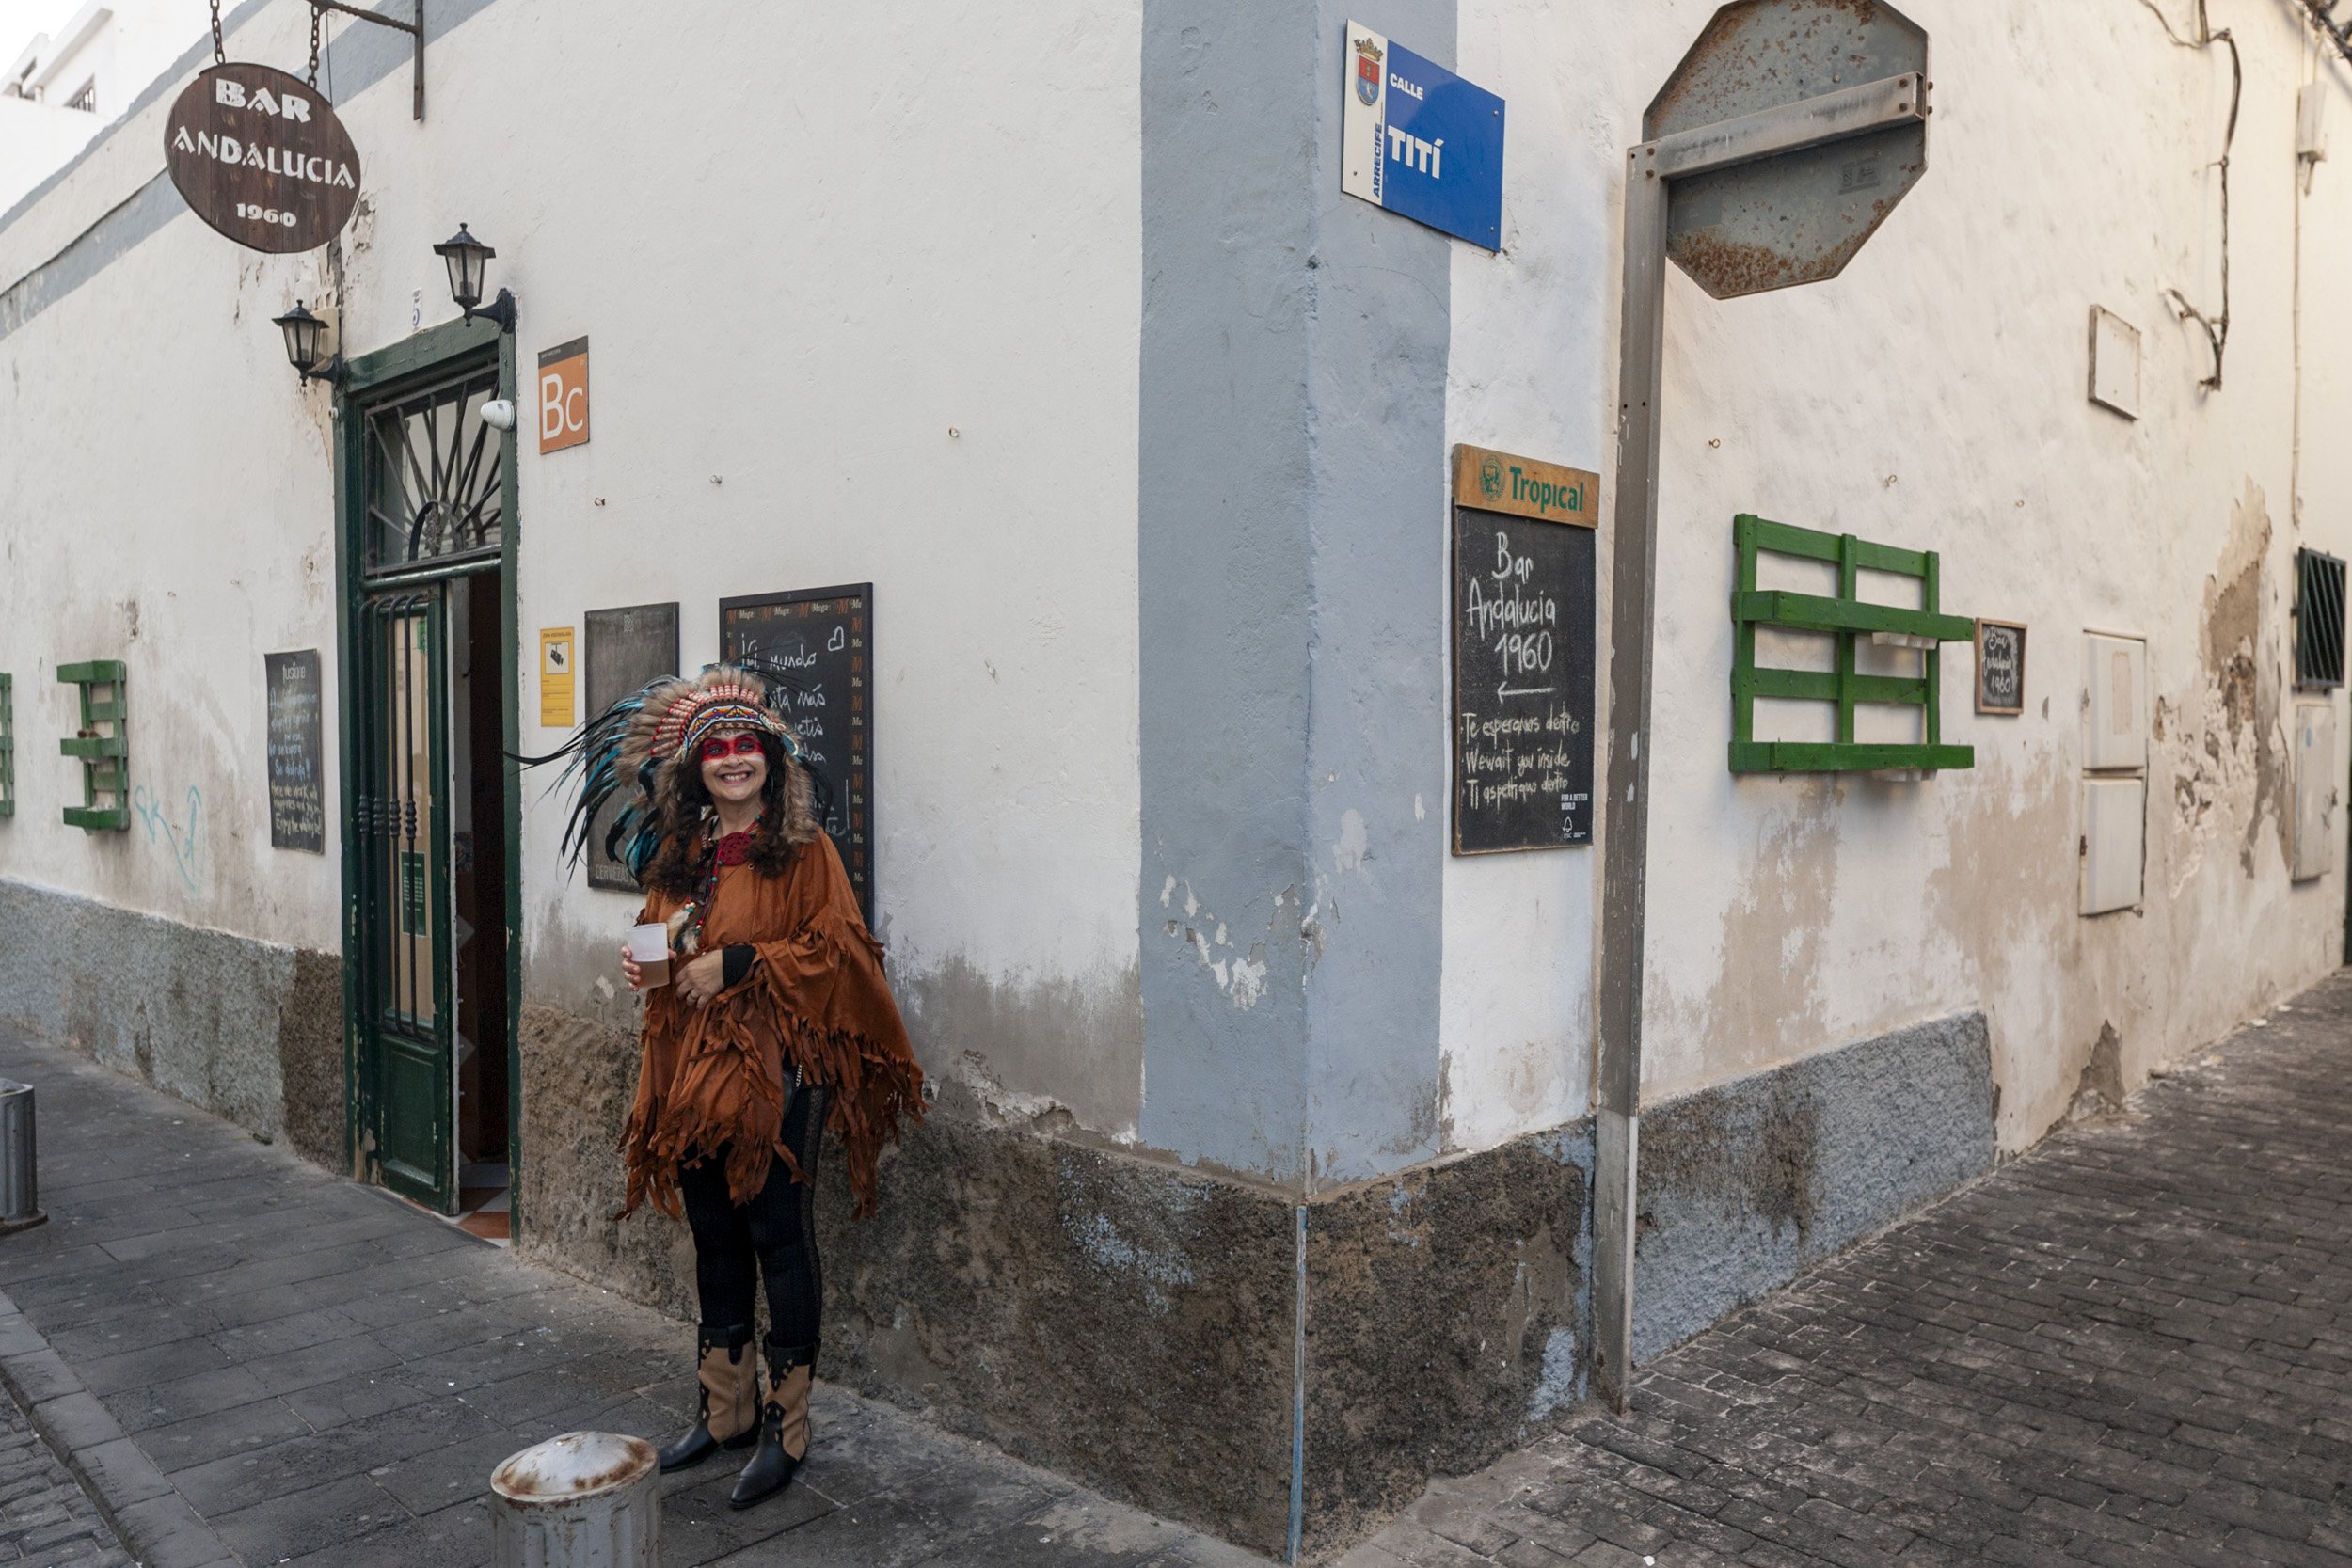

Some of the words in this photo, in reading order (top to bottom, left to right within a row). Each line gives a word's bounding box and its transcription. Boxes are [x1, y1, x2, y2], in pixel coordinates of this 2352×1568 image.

[215, 78, 311, 123] BAR
[1390, 73, 1423, 101] CALLE
[171, 125, 355, 190] ANDALUCIA
[1373, 122, 1383, 198] ARRECIFE
[1388, 125, 1444, 180] TITÍ
[236, 203, 297, 228] 1960
[541, 373, 583, 440] Bc
[1509, 466, 1584, 513] Tropical
[1491, 531, 1534, 584] Bar
[1494, 631, 1552, 676] 1960
[1990, 675, 2011, 694] 1960
[1461, 713, 1480, 744] Te
[1518, 753, 1534, 777] you
[1537, 738, 1570, 769] inside
[595, 864, 629, 883] CERVEZAS
